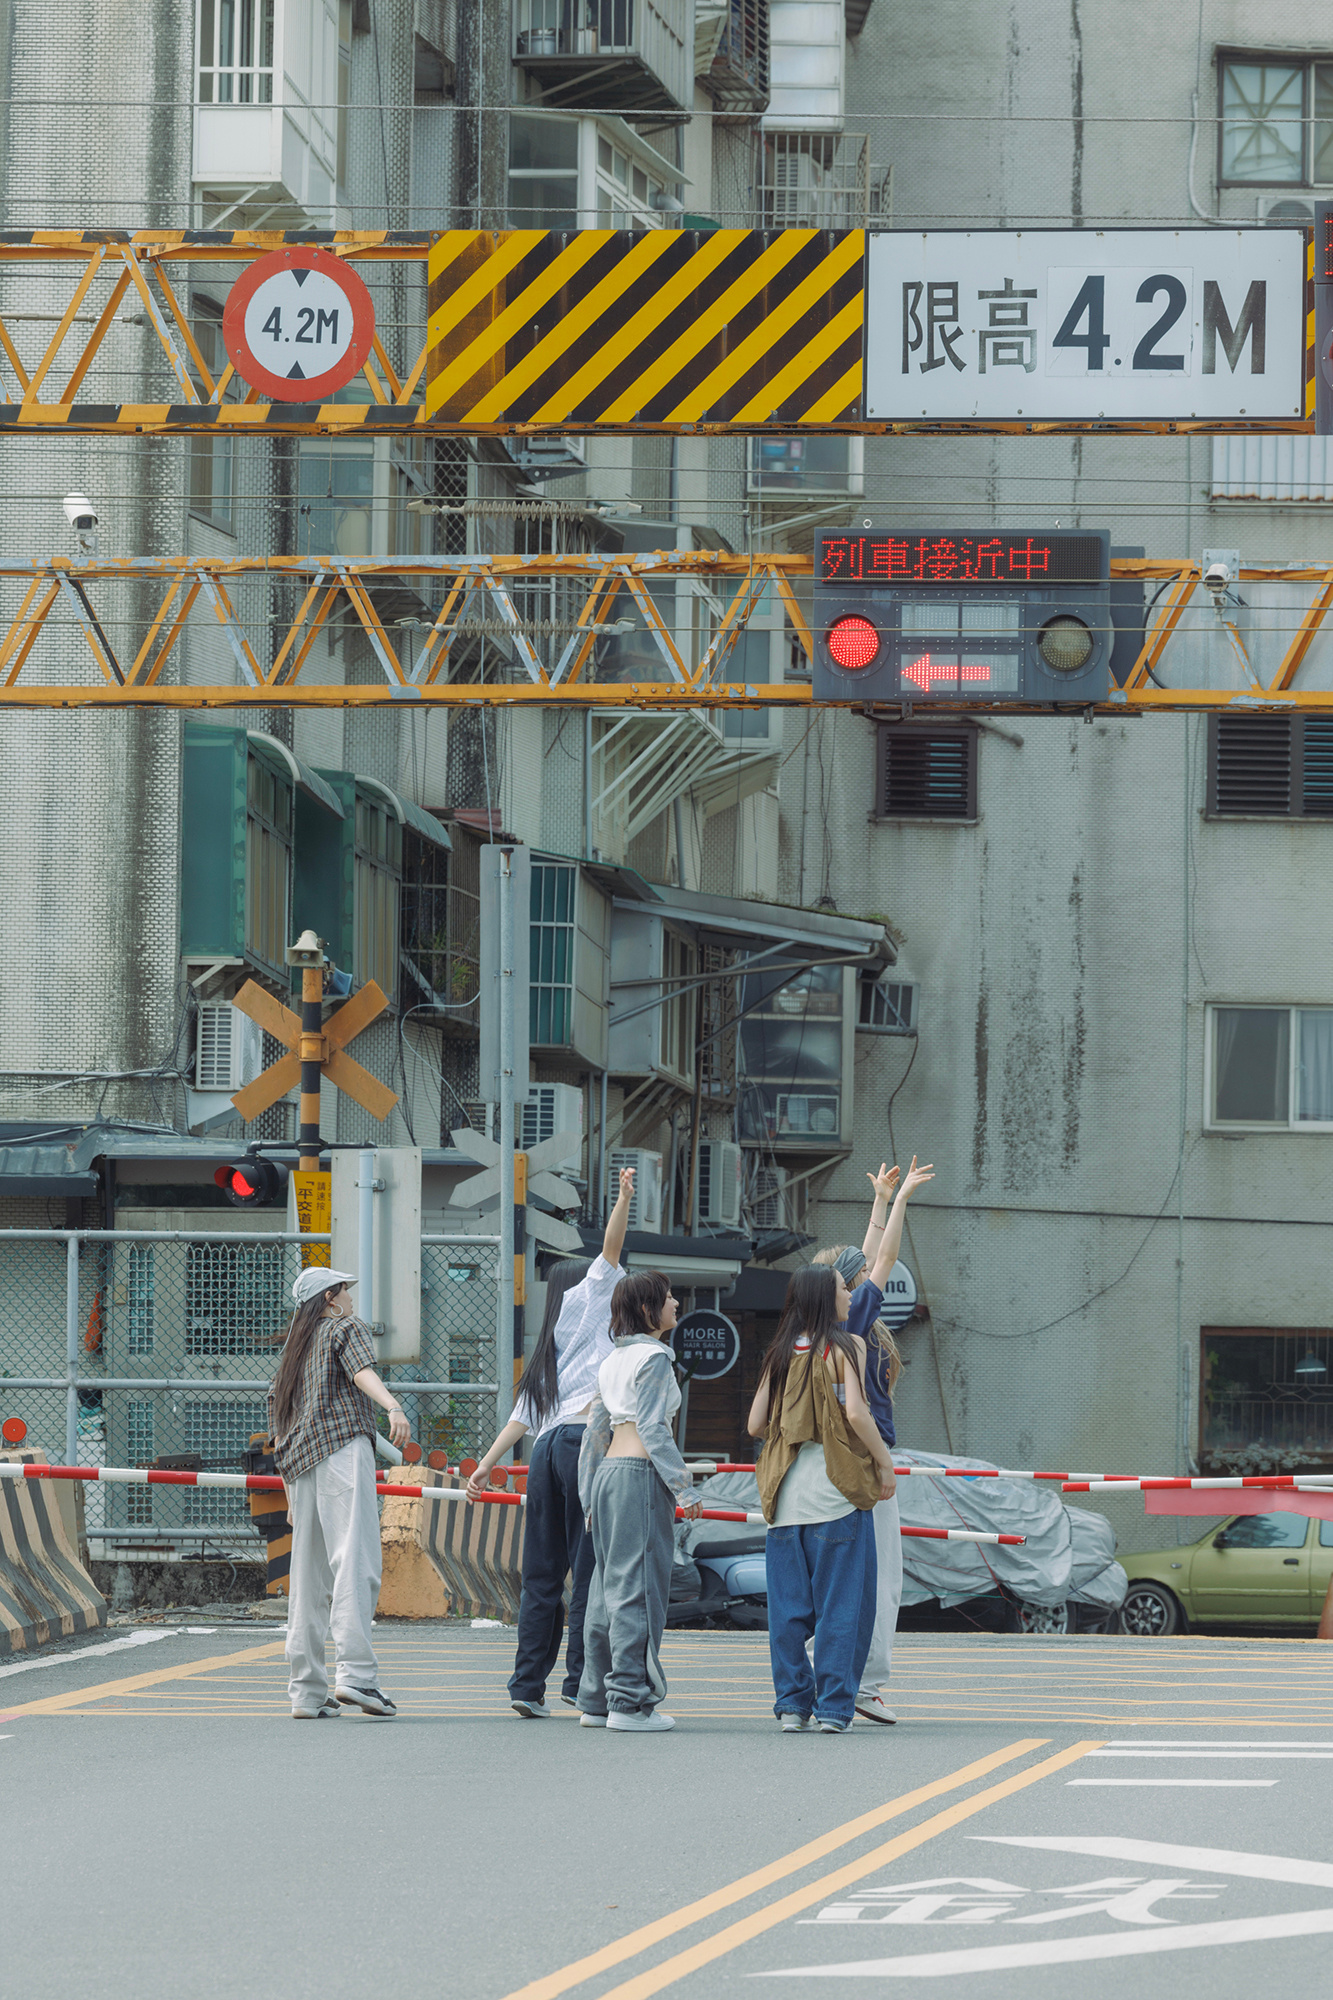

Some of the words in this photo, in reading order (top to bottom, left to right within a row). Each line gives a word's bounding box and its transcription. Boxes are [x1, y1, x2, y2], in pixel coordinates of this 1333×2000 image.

[261, 306, 339, 344] 4.2M
[822, 538, 1051, 581] 列車接近中
[683, 1328, 726, 1340] MORE
